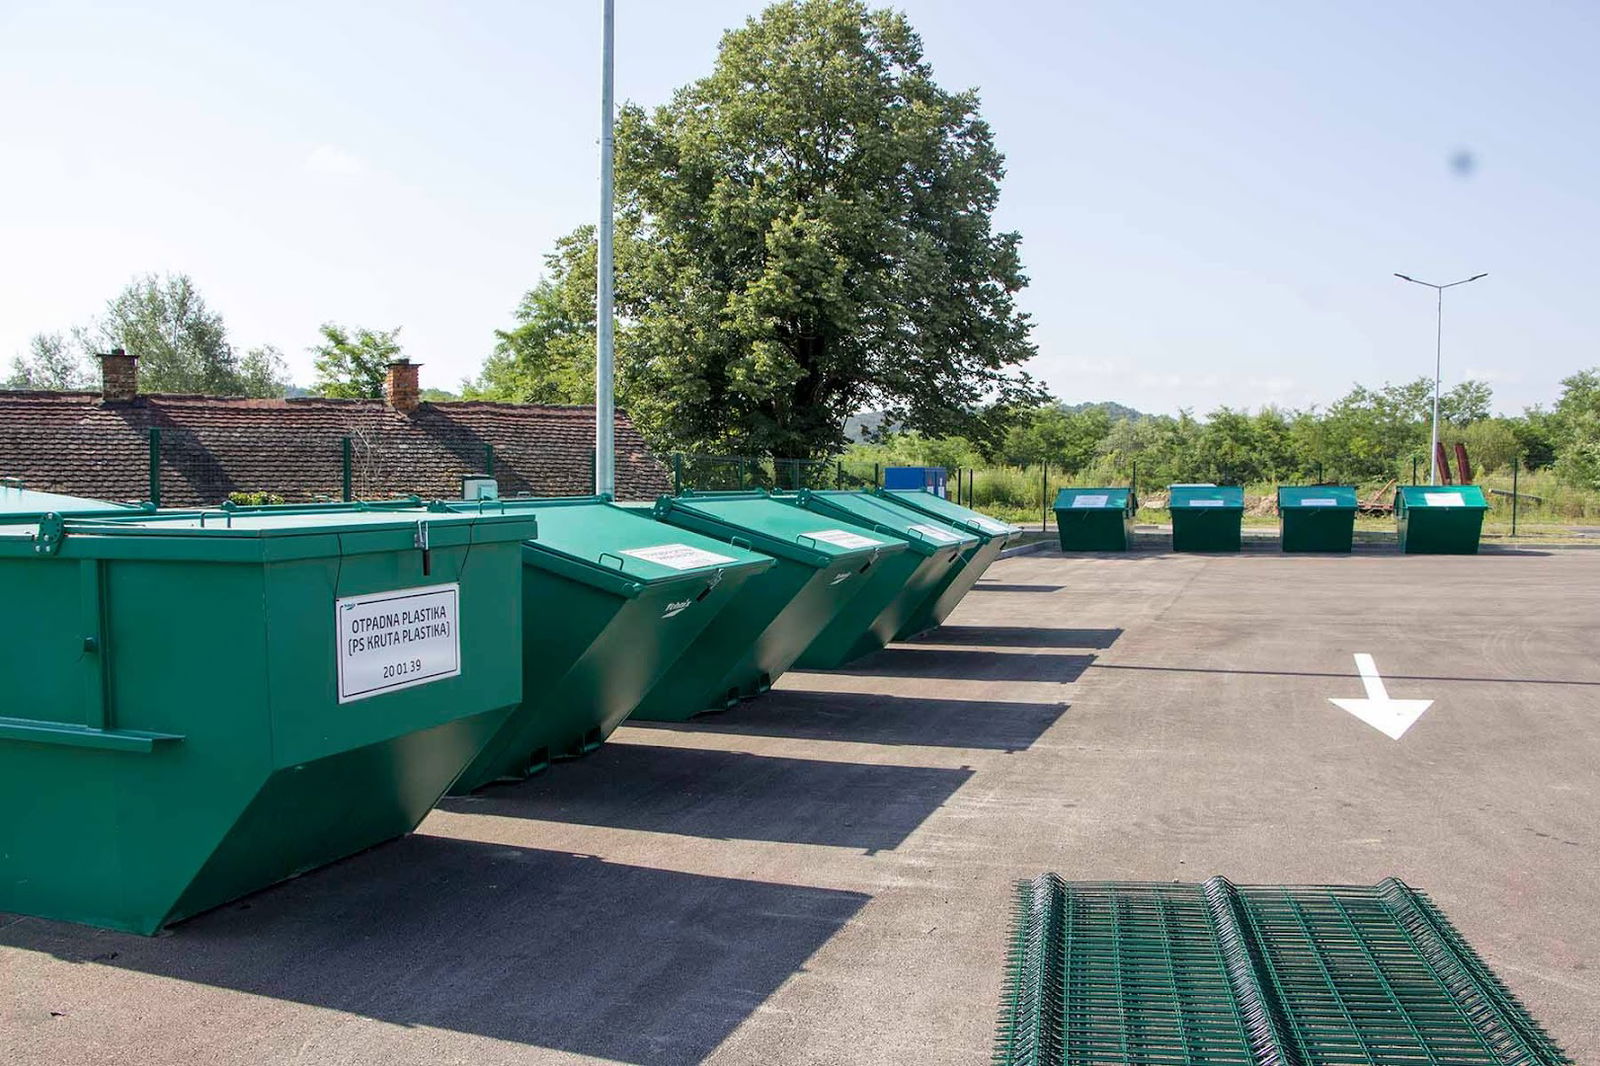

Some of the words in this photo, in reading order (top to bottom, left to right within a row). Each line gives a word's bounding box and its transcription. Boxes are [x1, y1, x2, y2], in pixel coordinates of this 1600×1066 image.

[352, 613, 400, 634] OTPADNA
[402, 605, 446, 625] PLASTIKA
[367, 631, 400, 650] KRUTA
[383, 665, 395, 678] 20
[396, 662, 408, 675] 01
[410, 658, 422, 672] 39
